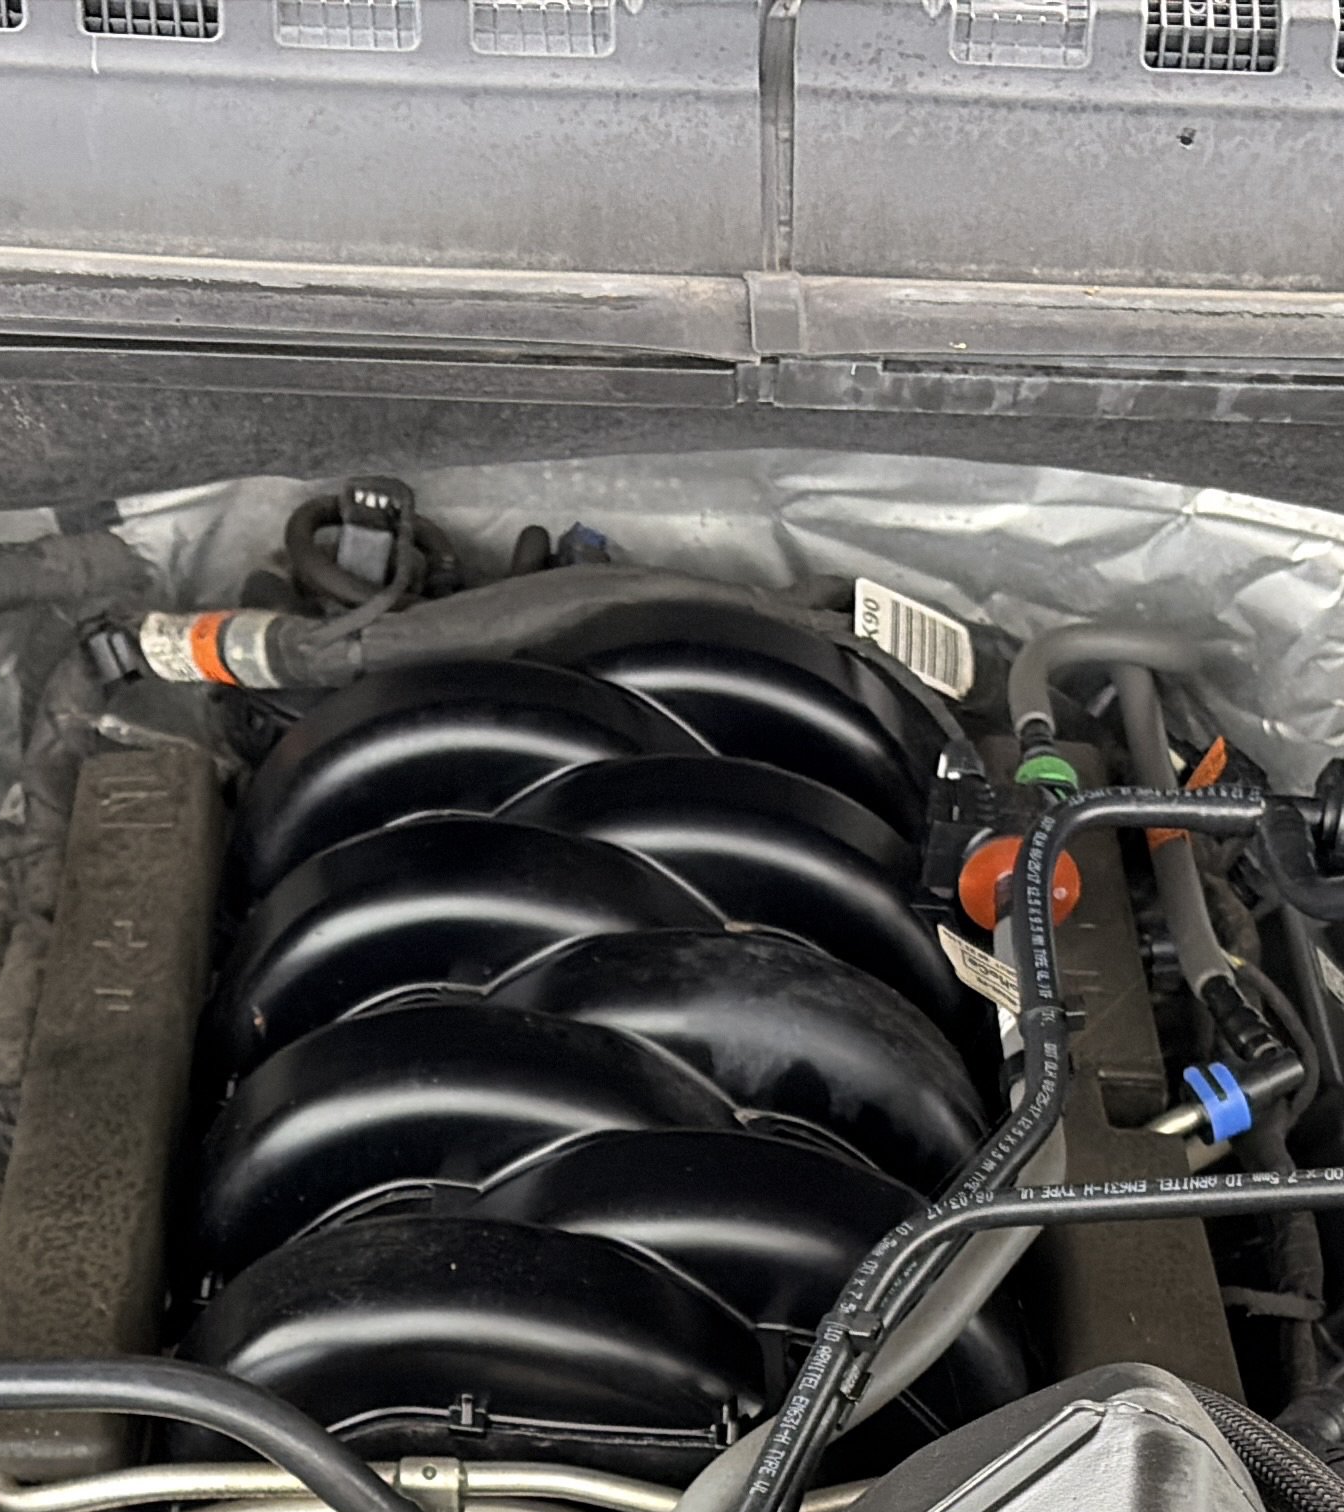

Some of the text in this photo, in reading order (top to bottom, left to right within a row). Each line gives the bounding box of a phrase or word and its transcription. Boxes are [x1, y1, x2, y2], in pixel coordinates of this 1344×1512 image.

[1156, 1175, 1218, 1192] ARNITEL
[1224, 1172, 1244, 1188] ID
[1041, 1185, 1076, 1200] TYPE
[758, 1446, 787, 1479] TYPE
[748, 1479, 769, 1496] UL
